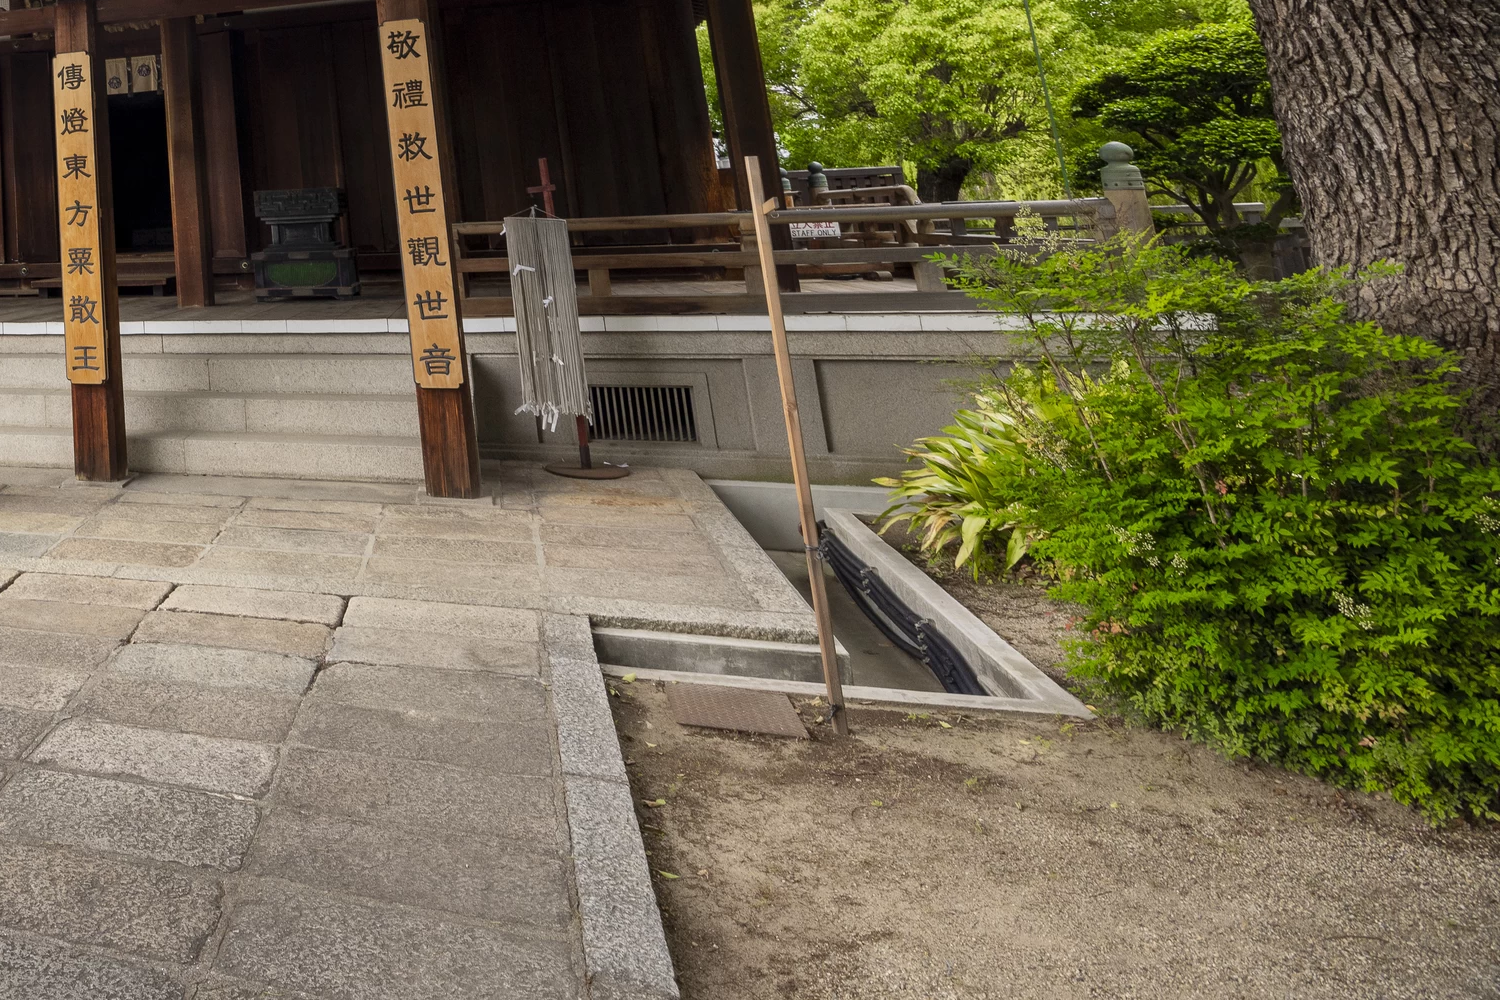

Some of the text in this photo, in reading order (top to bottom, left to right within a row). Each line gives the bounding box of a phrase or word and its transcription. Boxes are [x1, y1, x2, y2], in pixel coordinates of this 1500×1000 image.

[57, 63, 101, 372] 傳燈東方粟散王
[386, 30, 457, 377] 敬禮救世觀世音
[791, 229, 837, 237] STAFF ONLY
